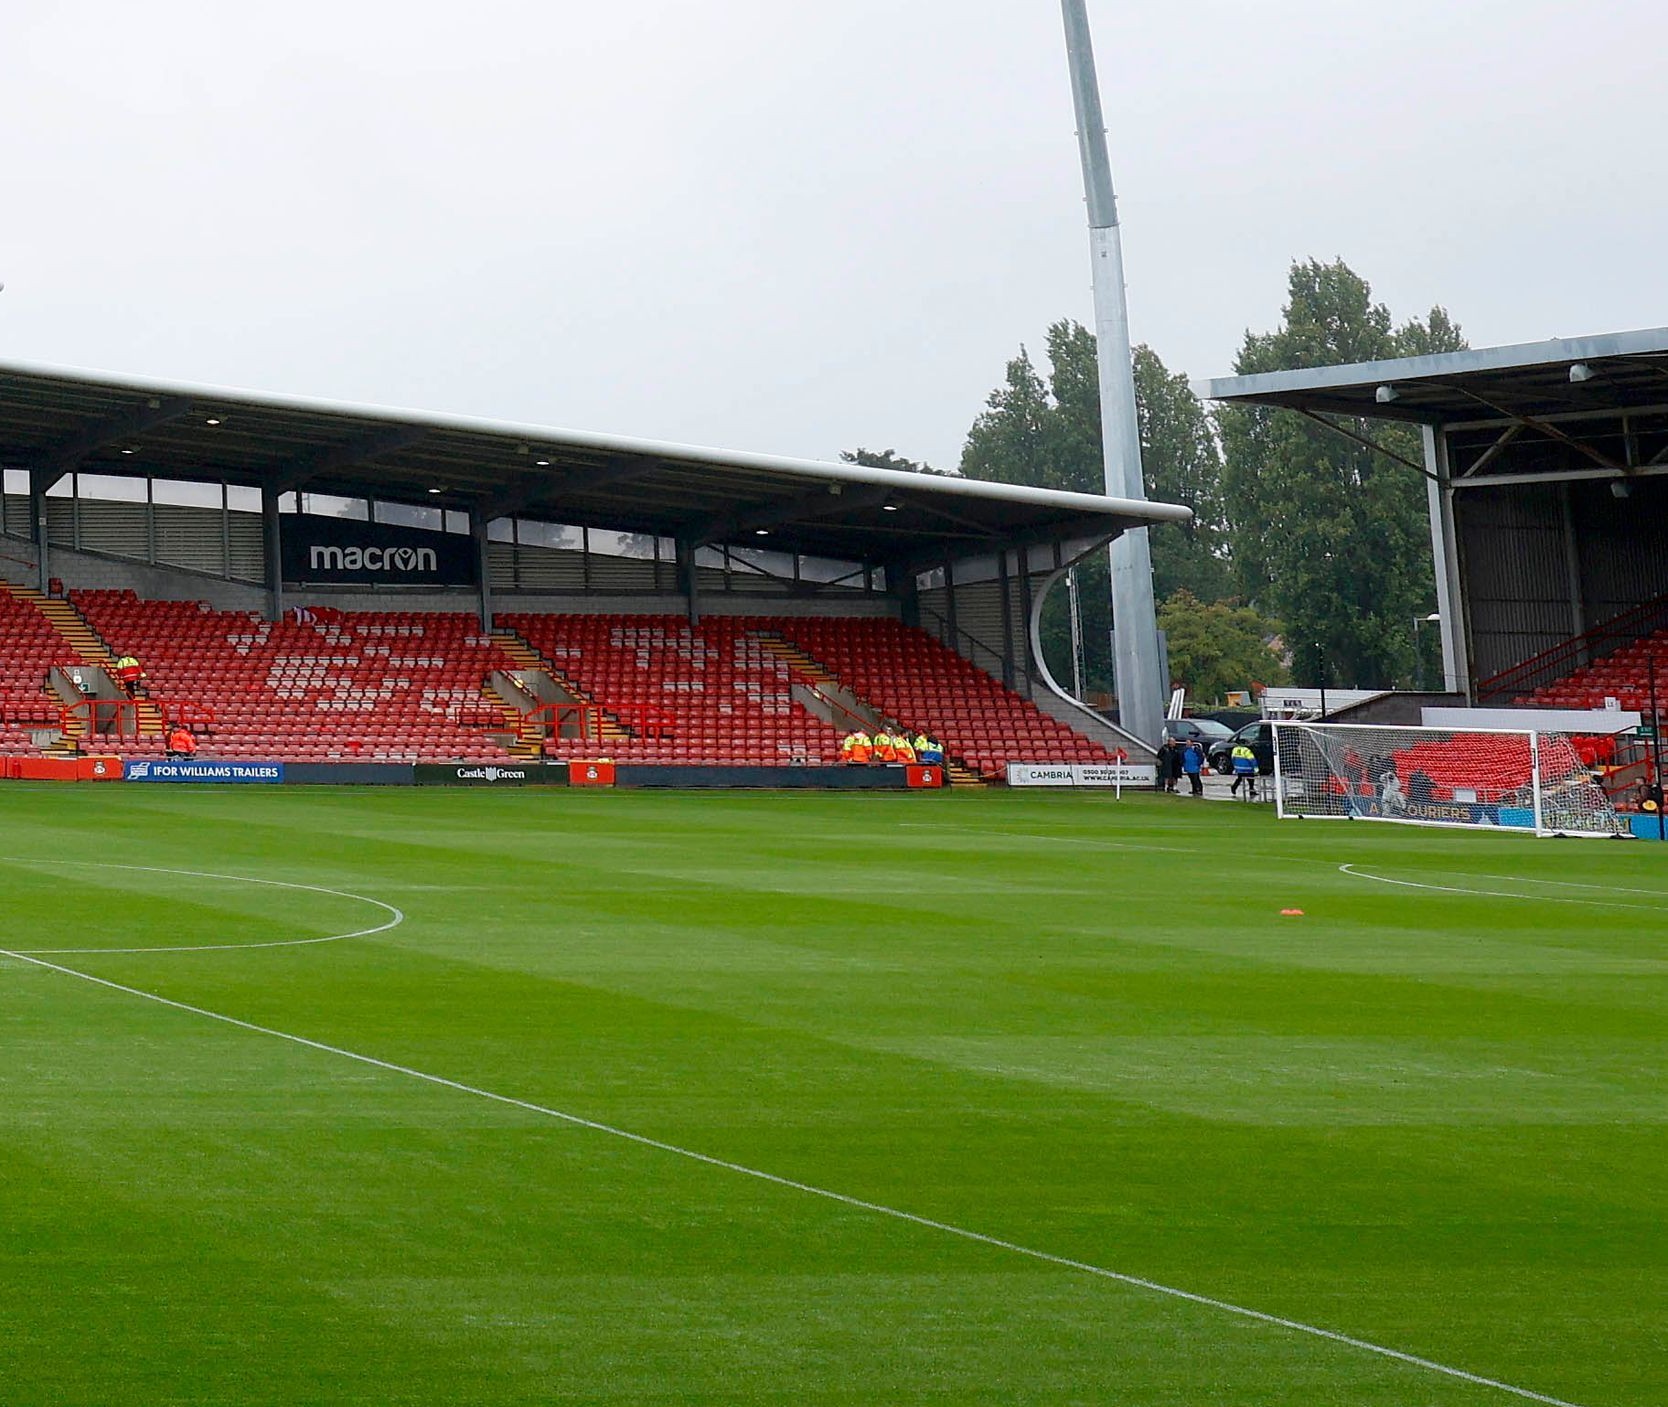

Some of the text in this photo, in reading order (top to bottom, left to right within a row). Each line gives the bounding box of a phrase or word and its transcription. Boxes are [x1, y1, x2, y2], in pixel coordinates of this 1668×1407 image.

[310, 545, 438, 571] macron
[153, 766, 279, 777] IFOR WILLIAMS TRAILERS
[456, 767, 525, 779] Castle Green
[1030, 771, 1073, 779] CAMBRIA
